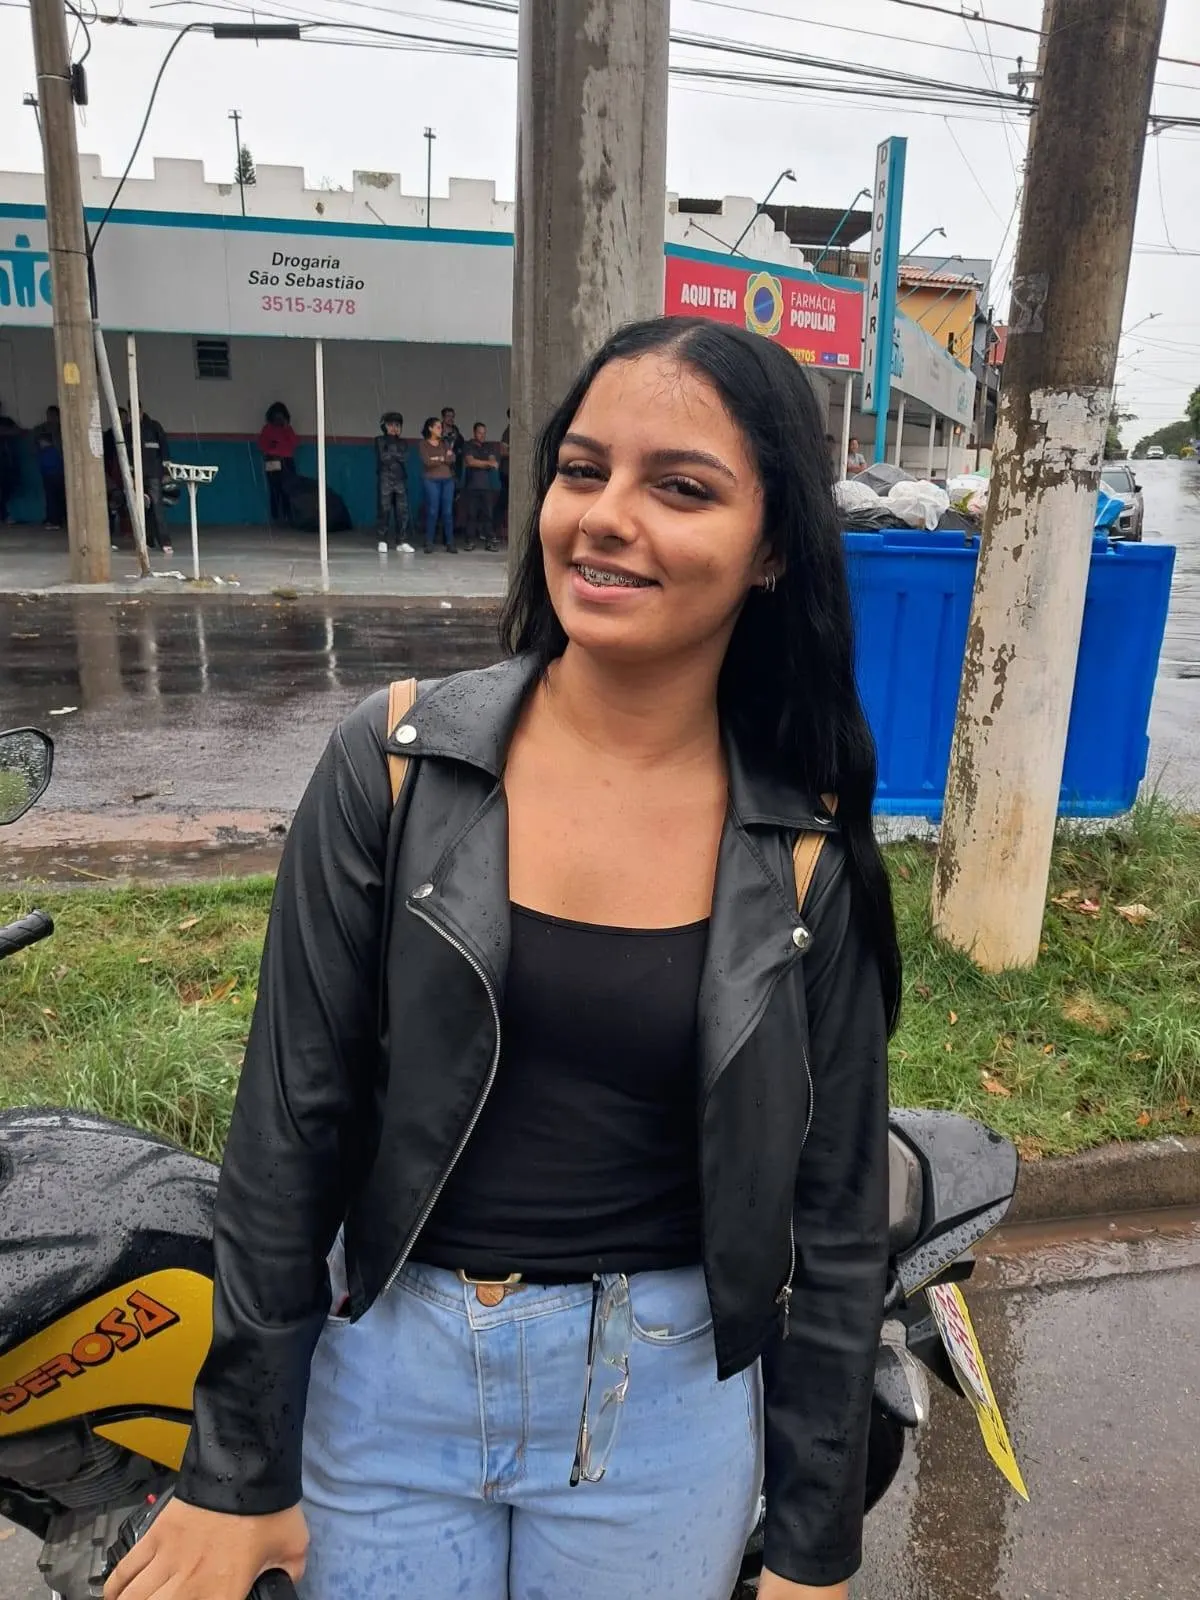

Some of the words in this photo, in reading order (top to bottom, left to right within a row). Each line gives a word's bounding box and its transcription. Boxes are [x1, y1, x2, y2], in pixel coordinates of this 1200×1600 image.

[271, 251, 341, 271] Drogaria
[248, 270, 280, 286] São
[285, 272, 365, 290] Sebastião
[864, 146, 888, 400] DROGARIA
[262, 295, 356, 315] 3515-3478
[681, 283, 711, 307] AQUI
[713, 287, 737, 309] TEM
[790, 291, 836, 313] FARMÁCIA
[790, 309, 836, 332] POPULAR
